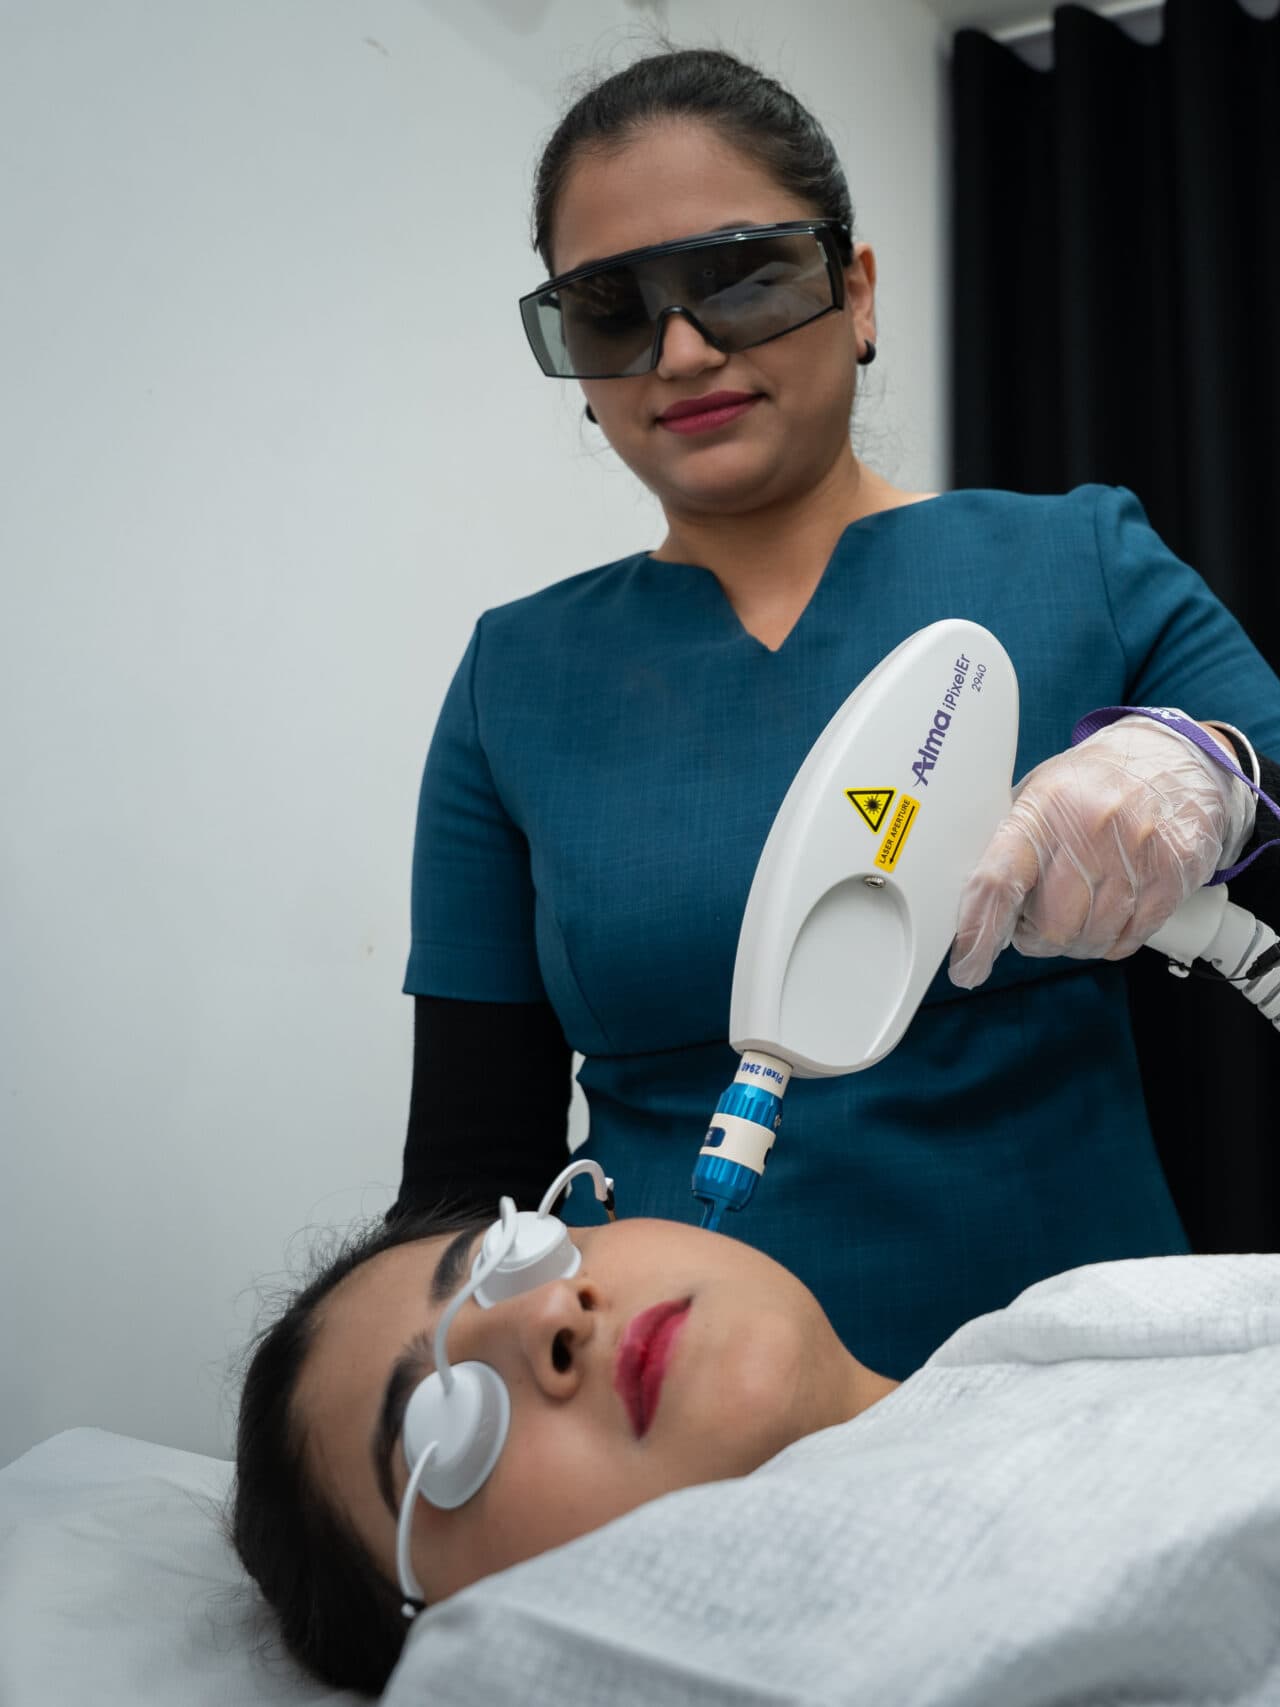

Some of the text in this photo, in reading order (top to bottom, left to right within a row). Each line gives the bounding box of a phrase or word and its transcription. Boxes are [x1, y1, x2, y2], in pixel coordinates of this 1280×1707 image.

[971, 664, 987, 692] 2940
[911, 653, 971, 787] Alma iPixelEr
[879, 799, 911, 864] LASER APERTURE
[762, 1067, 784, 1084] Pixel
